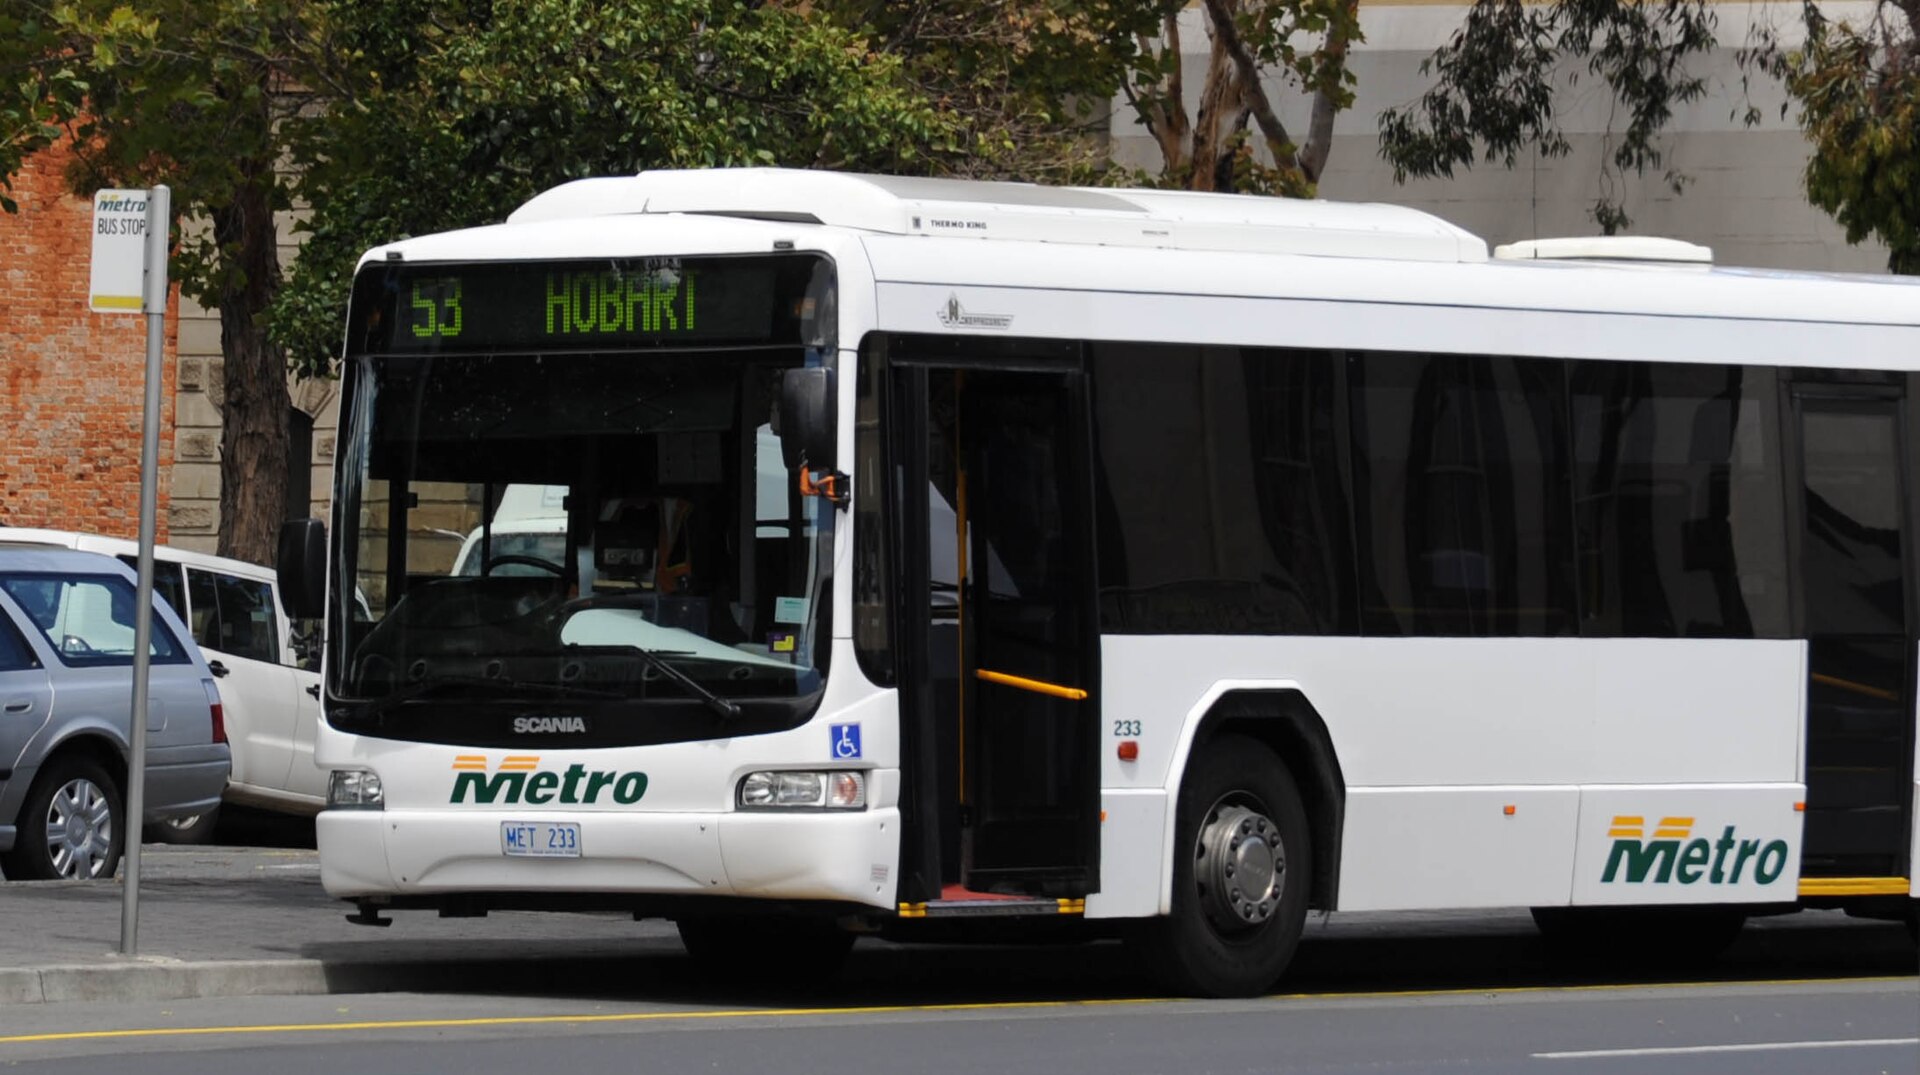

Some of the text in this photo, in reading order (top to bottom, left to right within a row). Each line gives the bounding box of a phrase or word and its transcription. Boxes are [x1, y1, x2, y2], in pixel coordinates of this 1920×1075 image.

[97, 217, 146, 236] BUS STOP
[930, 219, 987, 230] THERMO KING
[412, 272, 694, 336] 53 HOBART
[513, 716, 586, 733] SCANIA
[1113, 719, 1142, 737] 233
[449, 755, 649, 805] Metro
[506, 827, 576, 849] MET 233
[1600, 815, 1788, 885] Metro
